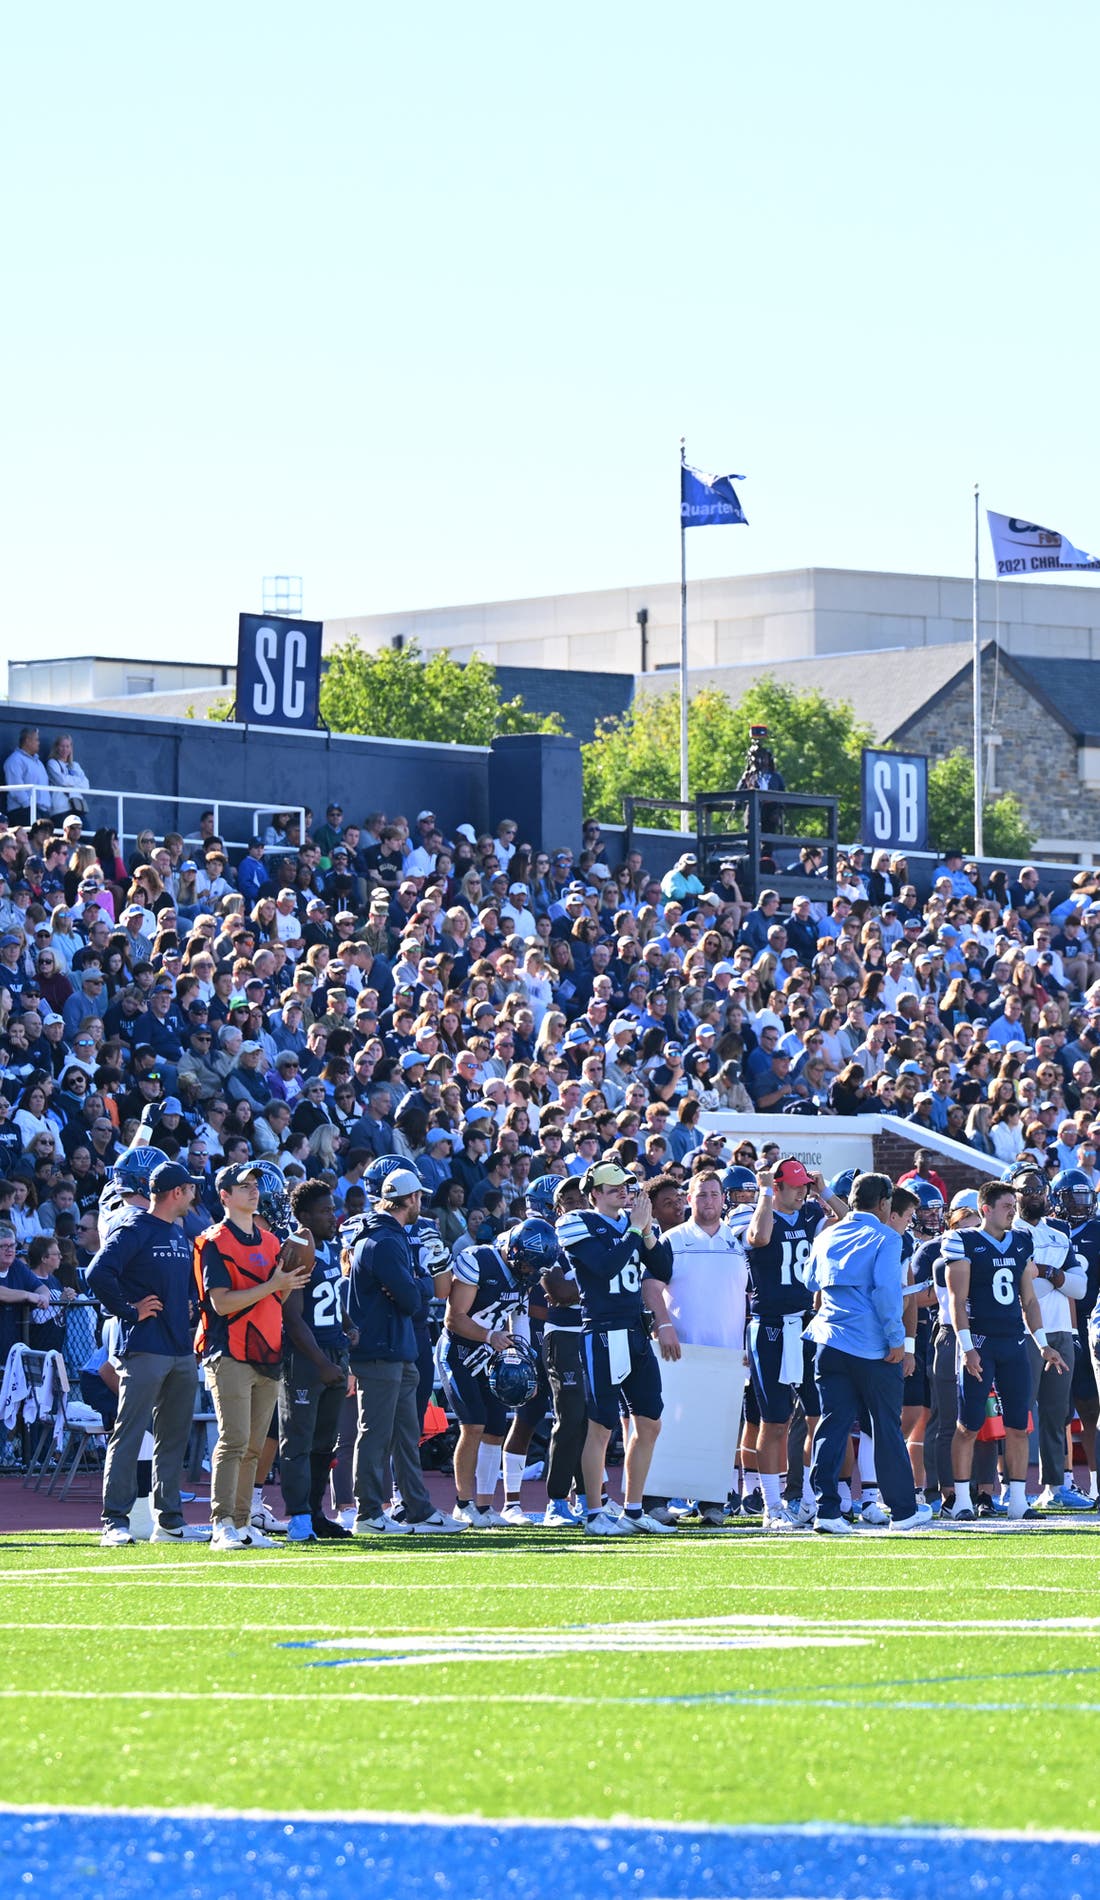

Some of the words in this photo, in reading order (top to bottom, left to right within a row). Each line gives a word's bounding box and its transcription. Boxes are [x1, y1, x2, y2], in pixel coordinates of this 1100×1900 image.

[998, 558, 1026, 573] 2021
[253, 627, 307, 718] SC
[874, 761, 918, 842] SB
[992, 1268, 1014, 1305] 6
